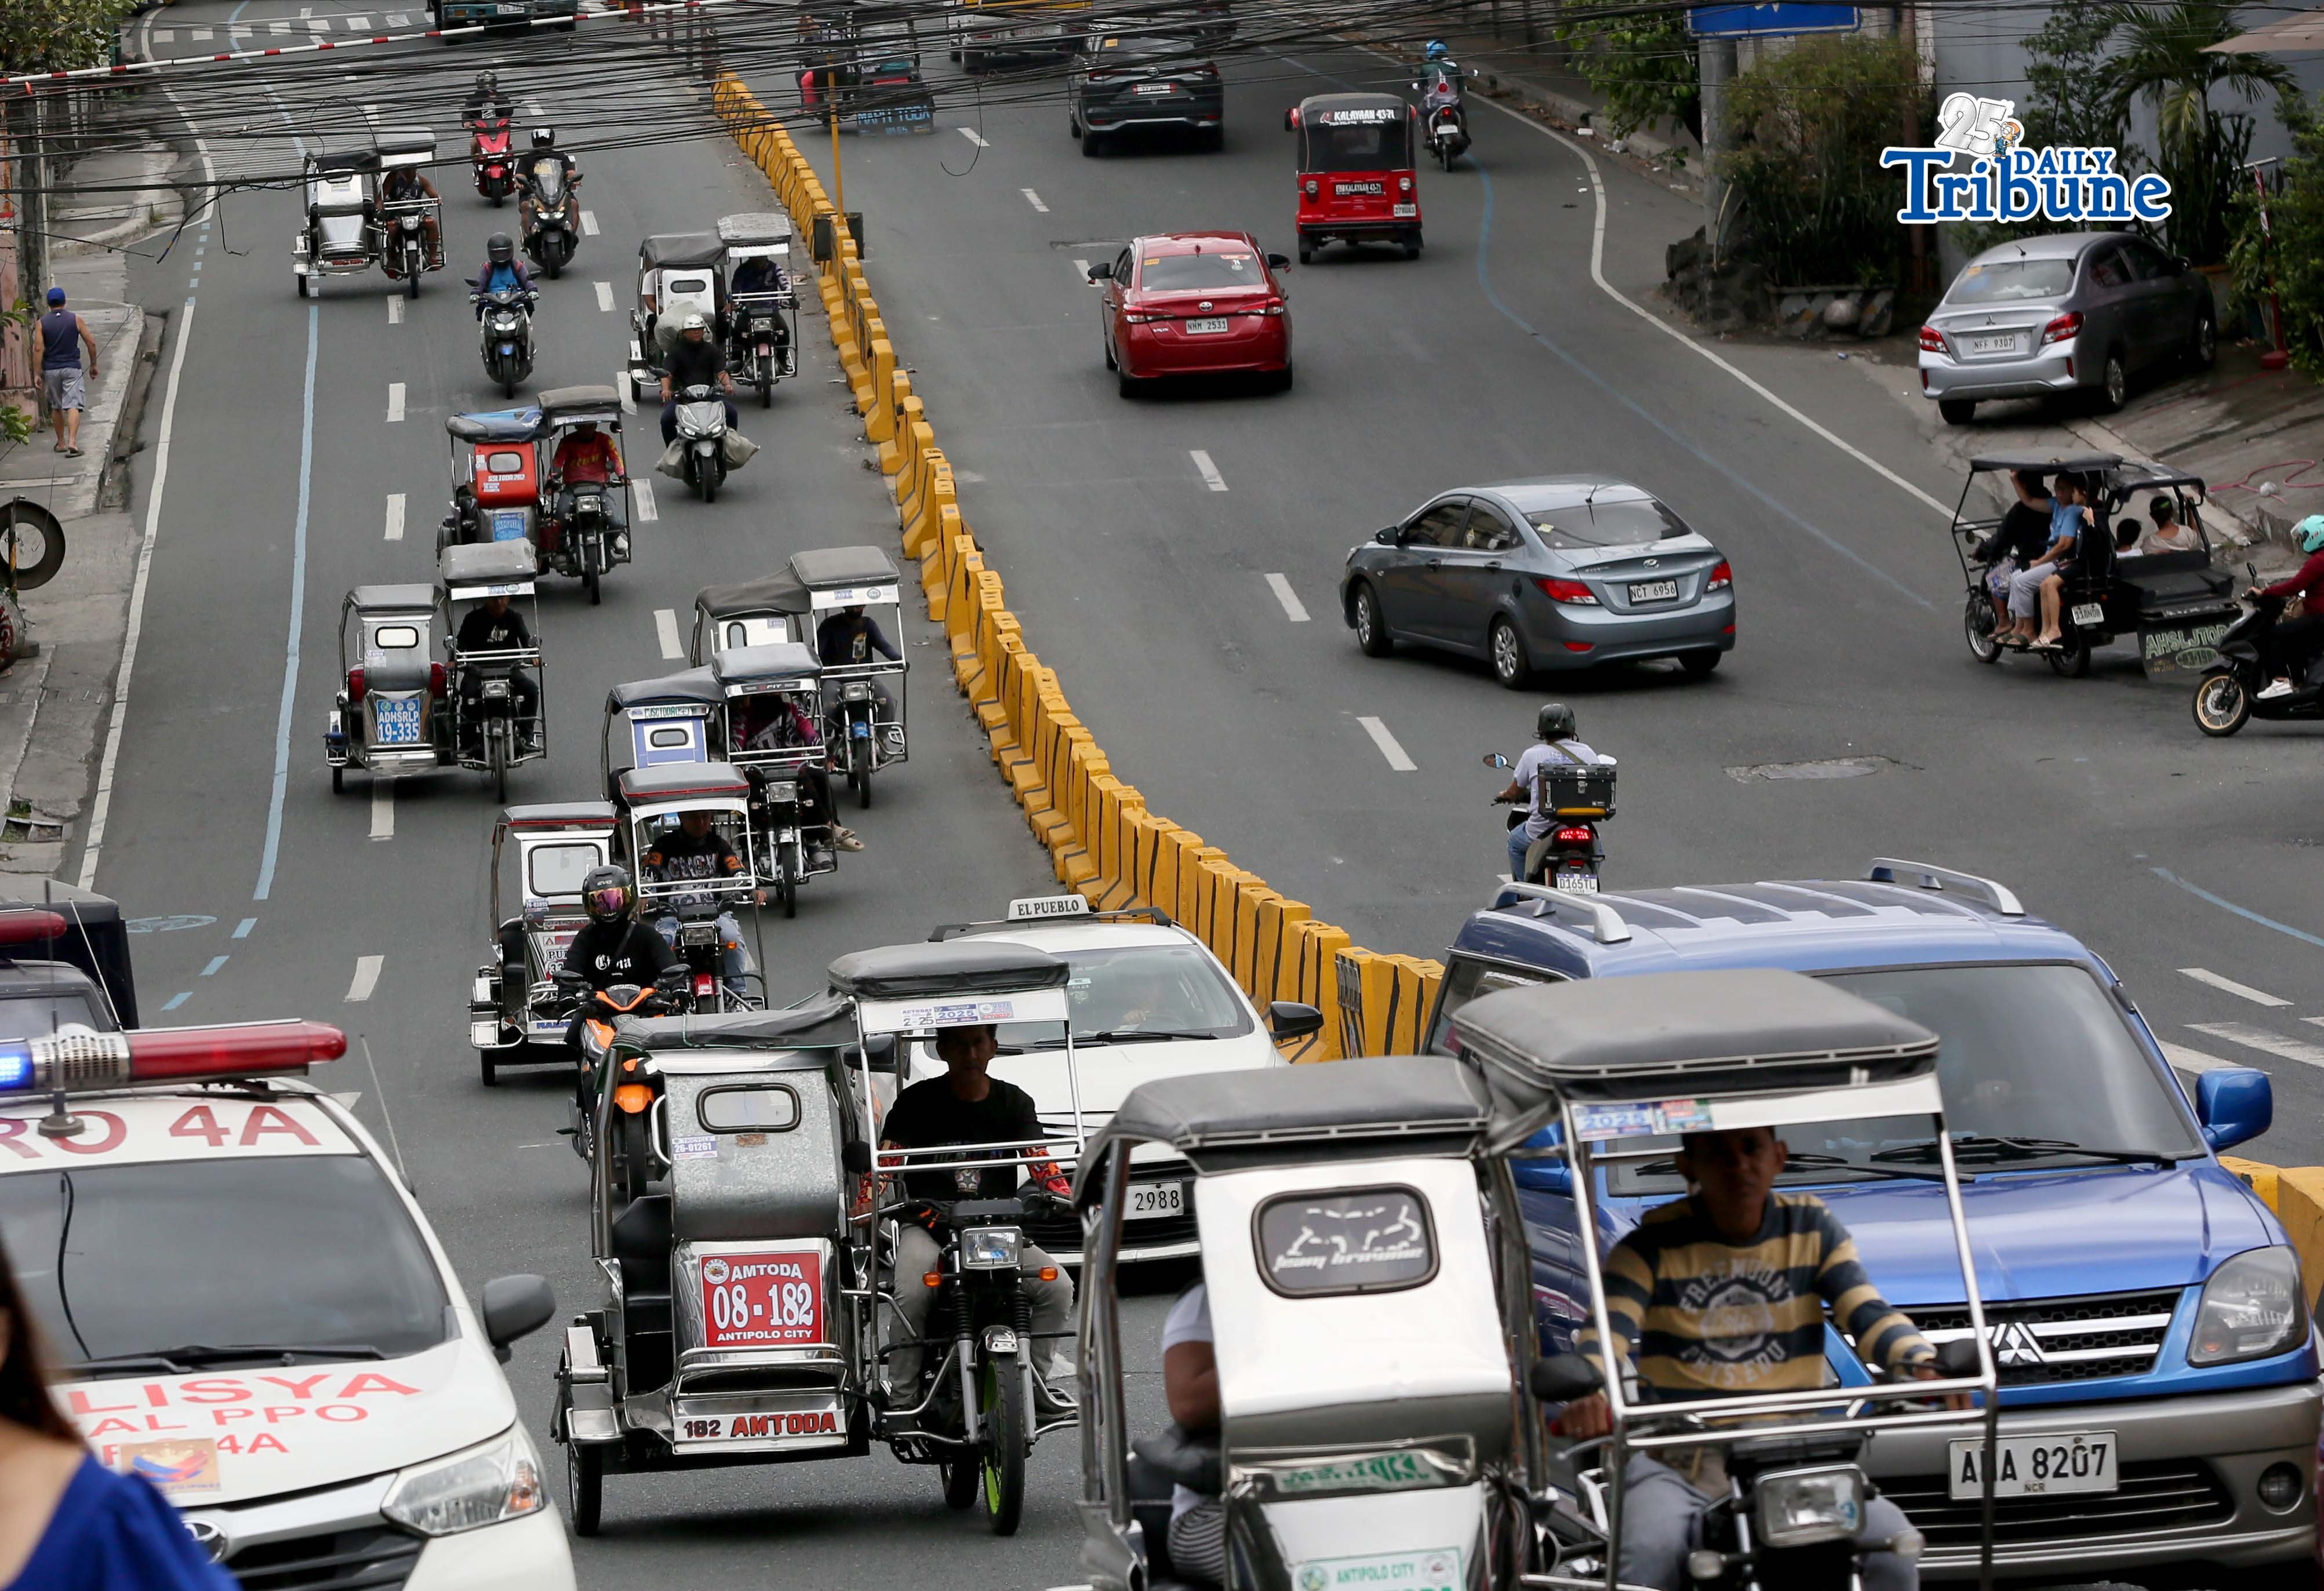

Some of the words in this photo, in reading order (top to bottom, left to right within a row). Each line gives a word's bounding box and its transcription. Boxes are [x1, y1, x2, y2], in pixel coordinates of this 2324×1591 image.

[1334, 110, 1375, 121] KALAYAAN
[1345, 184, 1369, 192] KALAYAAN
[1631, 587, 1647, 599] NCT
[1653, 584, 1675, 596] 6956
[379, 711, 419, 723] ADHSRLP
[378, 723, 419, 742] 19-335
[1559, 878, 1595, 890] D165TL
[1017, 904, 1032, 916] EL
[1033, 900, 1079, 914] PUEBLO
[939, 1010, 974, 1018] 2025
[169, 1106, 322, 1146] 4A
[674, 1142, 712, 1153] 26-01261
[1135, 1190, 1179, 1210] 2988
[730, 1263, 803, 1282] AMTODA
[717, 1330, 781, 1342] ANTIPOLO
[784, 1329, 813, 1339] CITY
[212, 1404, 369, 1426] PPO
[683, 1419, 721, 1438] 182
[730, 1412, 837, 1438] AMTODA
[2032, 1443, 2107, 1479] 8207
[2024, 1482, 2045, 1492] NCR
